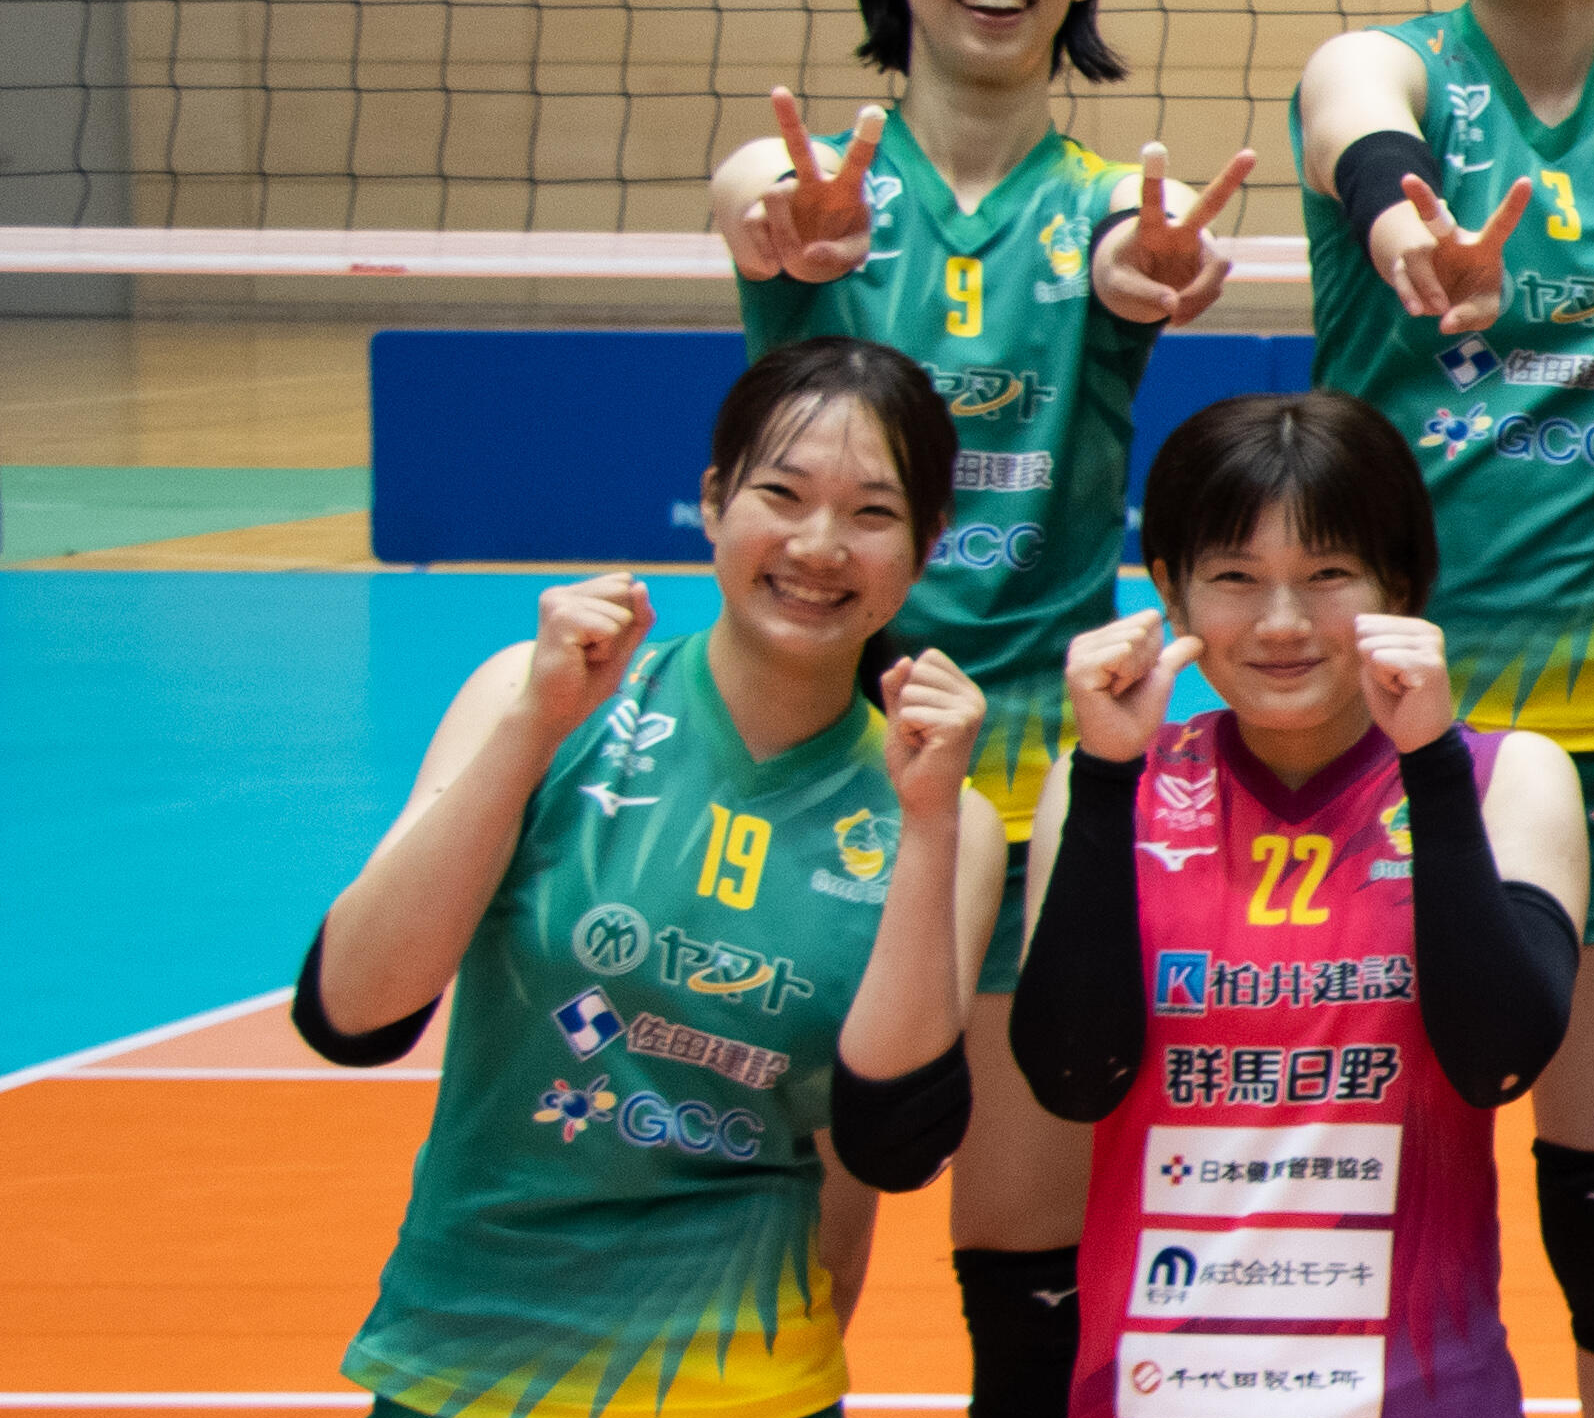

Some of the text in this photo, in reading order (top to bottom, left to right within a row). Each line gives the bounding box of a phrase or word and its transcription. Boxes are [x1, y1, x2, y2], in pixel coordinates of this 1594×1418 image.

[1540, 171, 1582, 241] 3
[945, 256, 982, 338] 9
[696, 802, 772, 910] 19
[1246, 834, 1333, 926] 22
[656, 925, 815, 1015] ヤマト
[1211, 955, 1416, 1009] 柏井建設
[1165, 1045, 1402, 1106] 群馬日野
[618, 1089, 766, 1162] GCC
